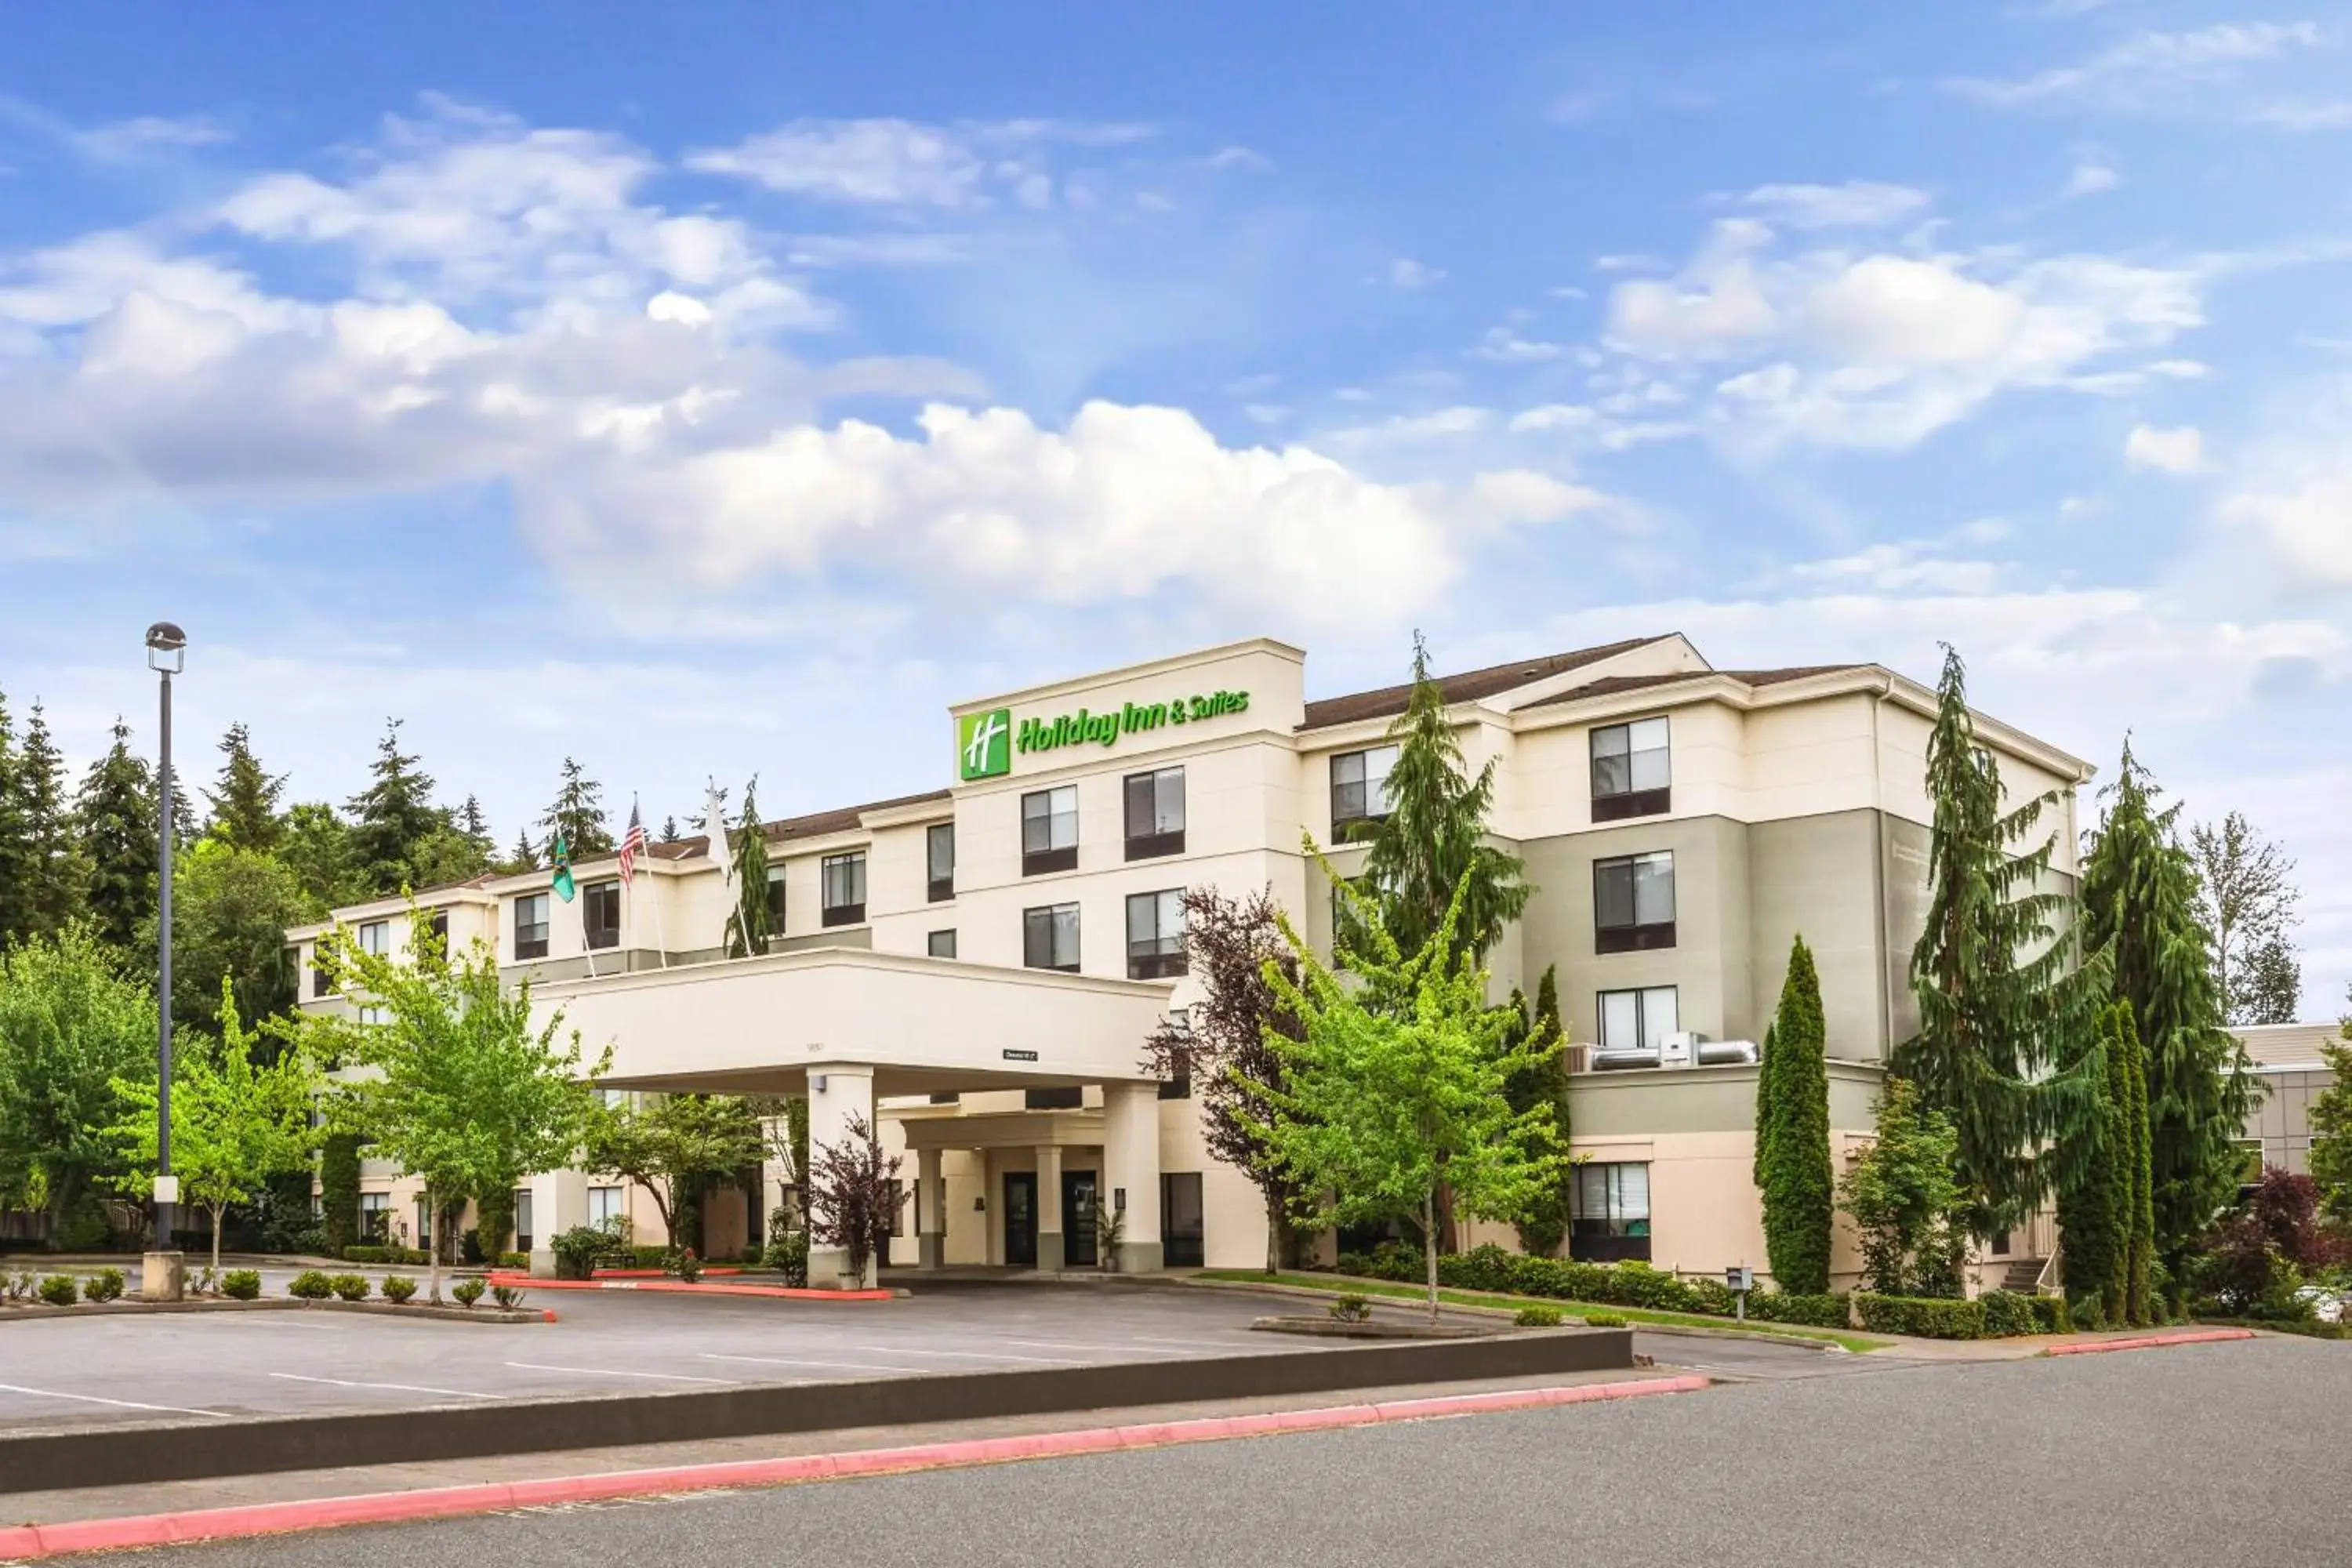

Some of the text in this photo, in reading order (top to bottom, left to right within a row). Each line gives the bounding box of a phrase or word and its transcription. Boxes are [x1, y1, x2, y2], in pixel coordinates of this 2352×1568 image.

[1017, 691, 1249, 754] Holiday Inn & Suites
